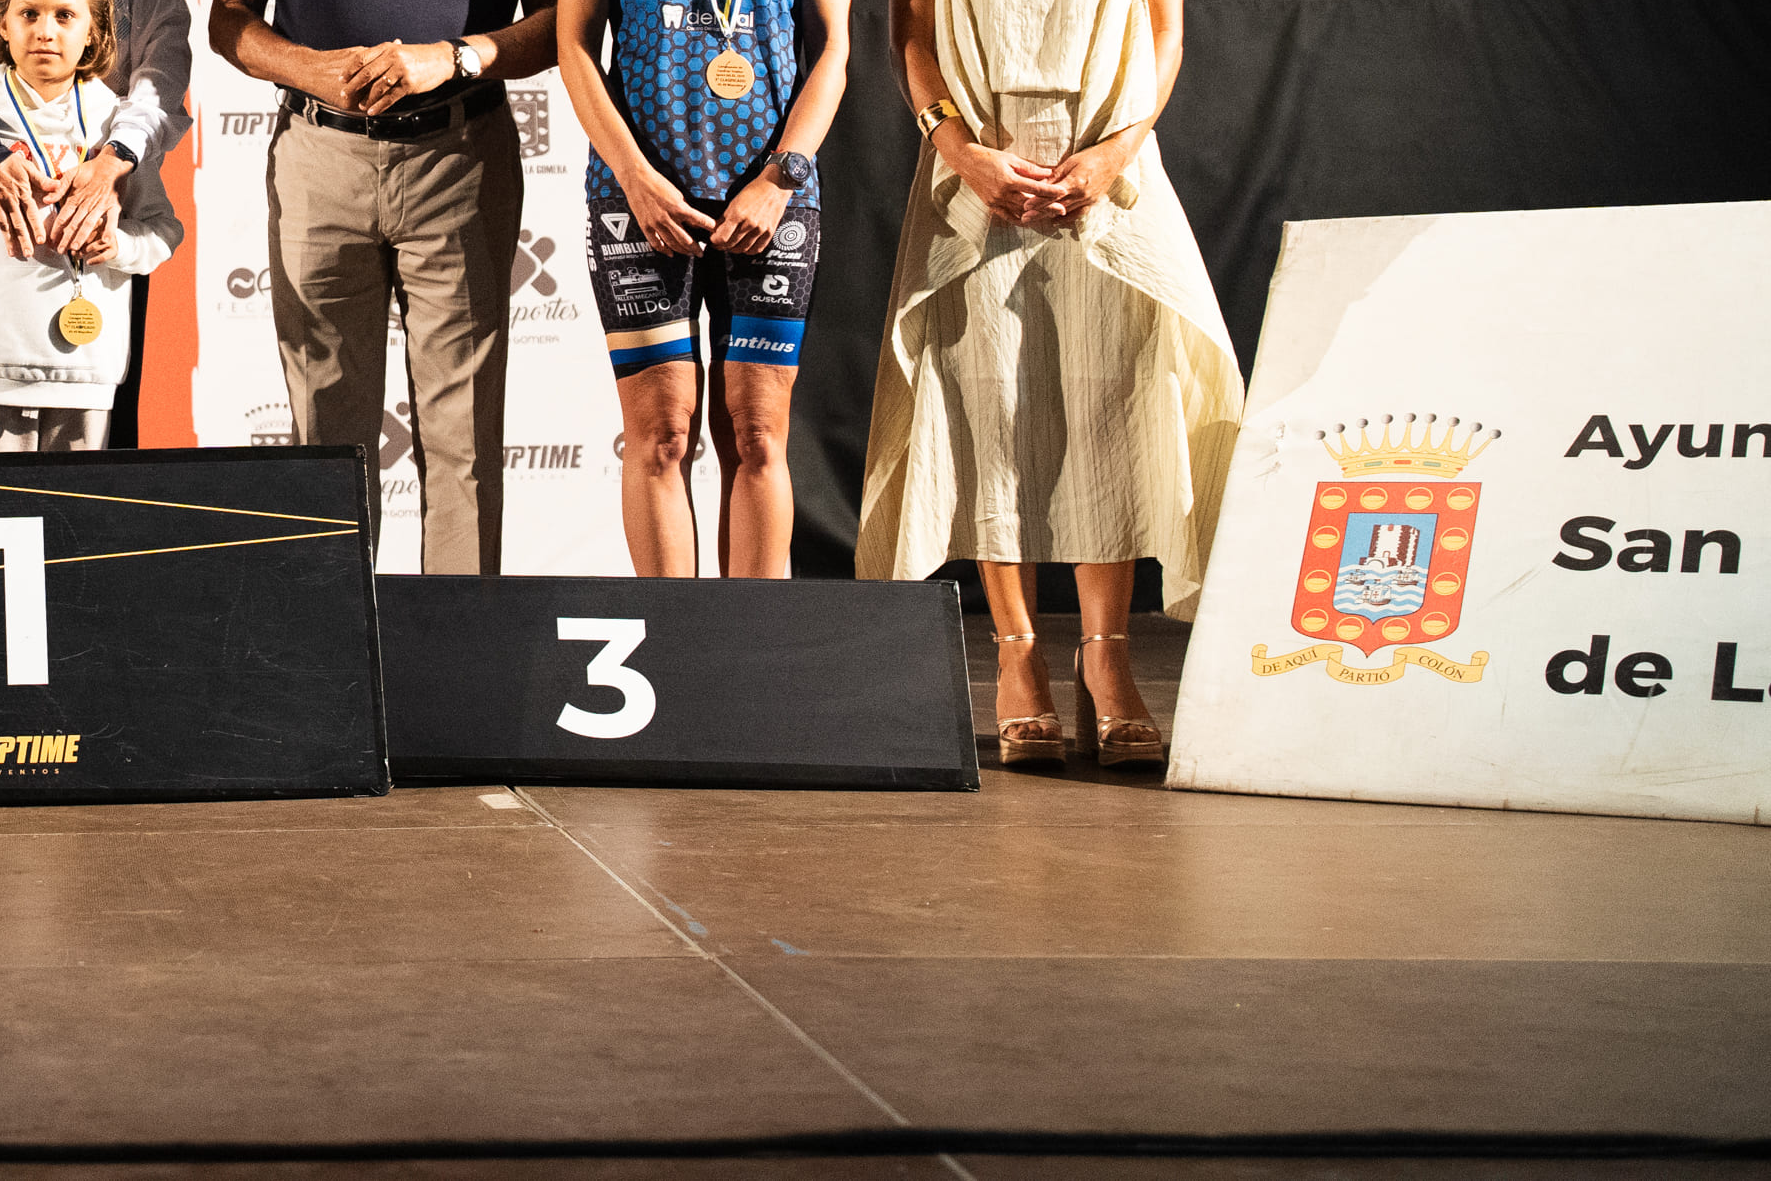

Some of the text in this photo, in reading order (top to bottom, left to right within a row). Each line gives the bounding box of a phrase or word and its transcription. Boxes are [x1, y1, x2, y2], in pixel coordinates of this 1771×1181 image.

[220, 113, 278, 135] TOPT
[617, 297, 671, 317] HILDO
[1552, 516, 1741, 574] San
[556, 617, 656, 739] 3
[1262, 662, 1281, 674] DE
[1339, 667, 1390, 683] PARTIÓ
[1418, 655, 1464, 680] COLÓN
[1545, 635, 1771, 702] de L
